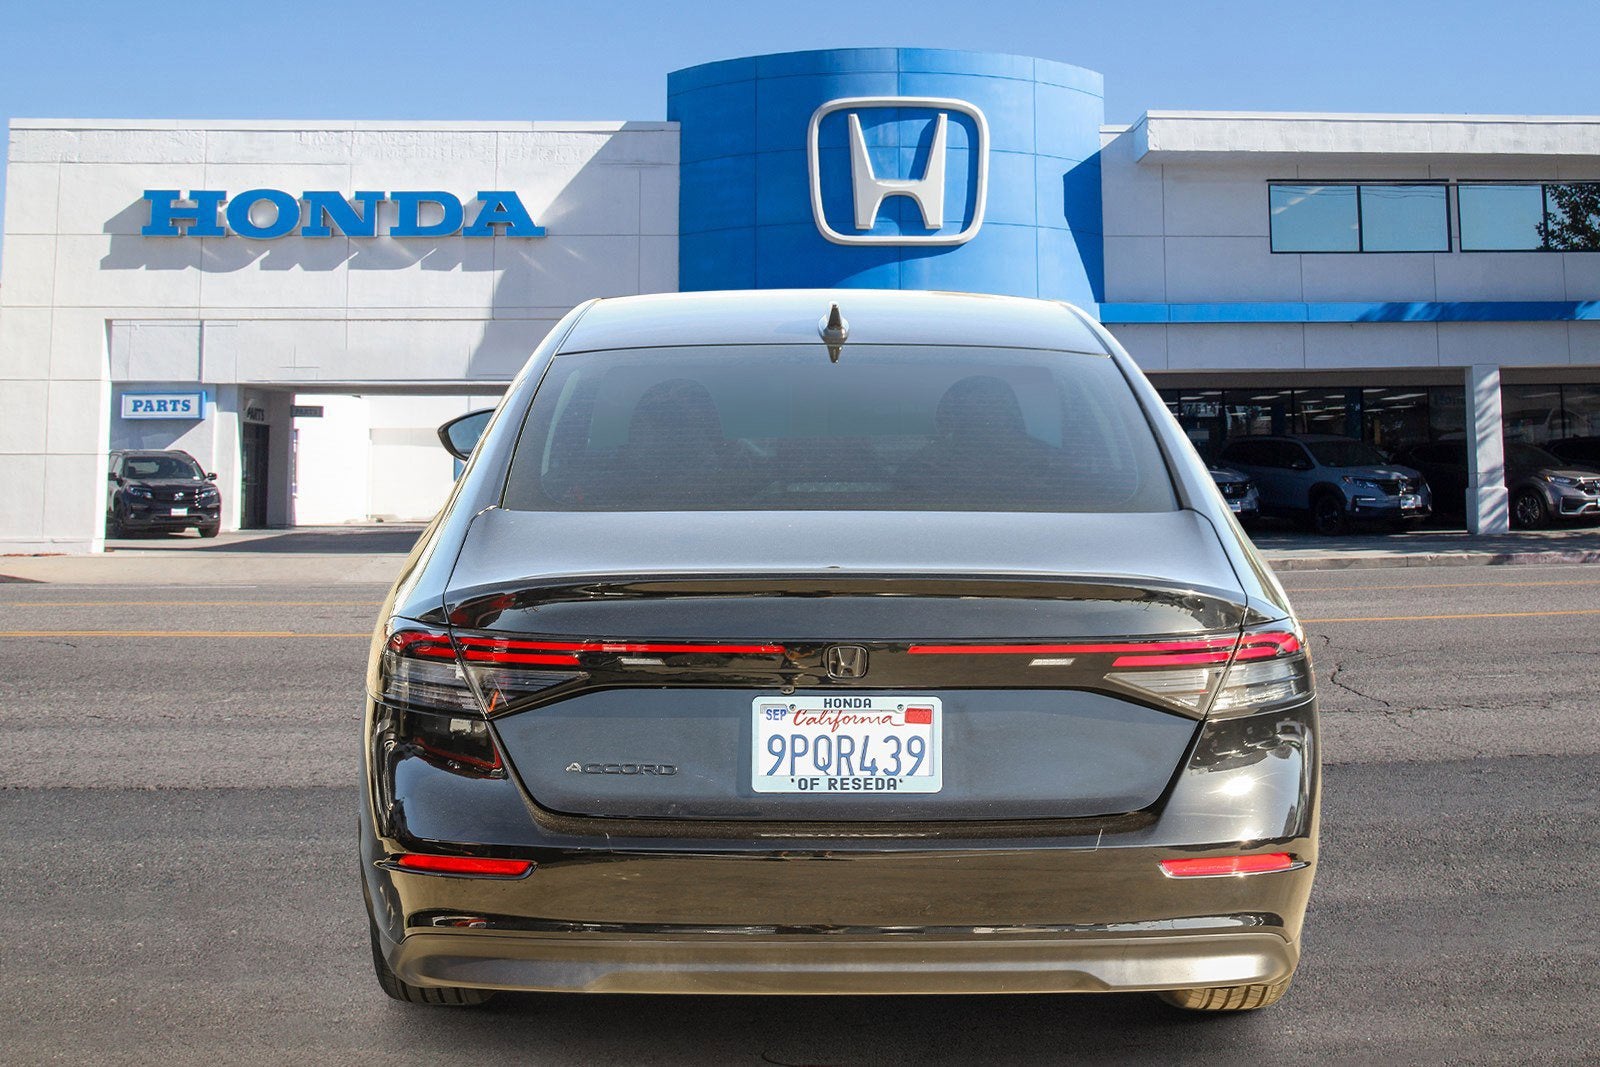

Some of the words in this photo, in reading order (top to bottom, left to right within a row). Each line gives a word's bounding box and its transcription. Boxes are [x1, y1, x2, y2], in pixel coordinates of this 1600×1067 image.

[141, 188, 547, 239] HONDA
[132, 399, 191, 412] PARTS
[823, 698, 872, 709] HONDA
[766, 709, 787, 721] SEP
[793, 709, 904, 733] California
[766, 734, 926, 777] 9PQR439
[565, 762, 678, 775] ACCORD
[797, 778, 820, 791] OF
[828, 778, 898, 791] RESEDA
